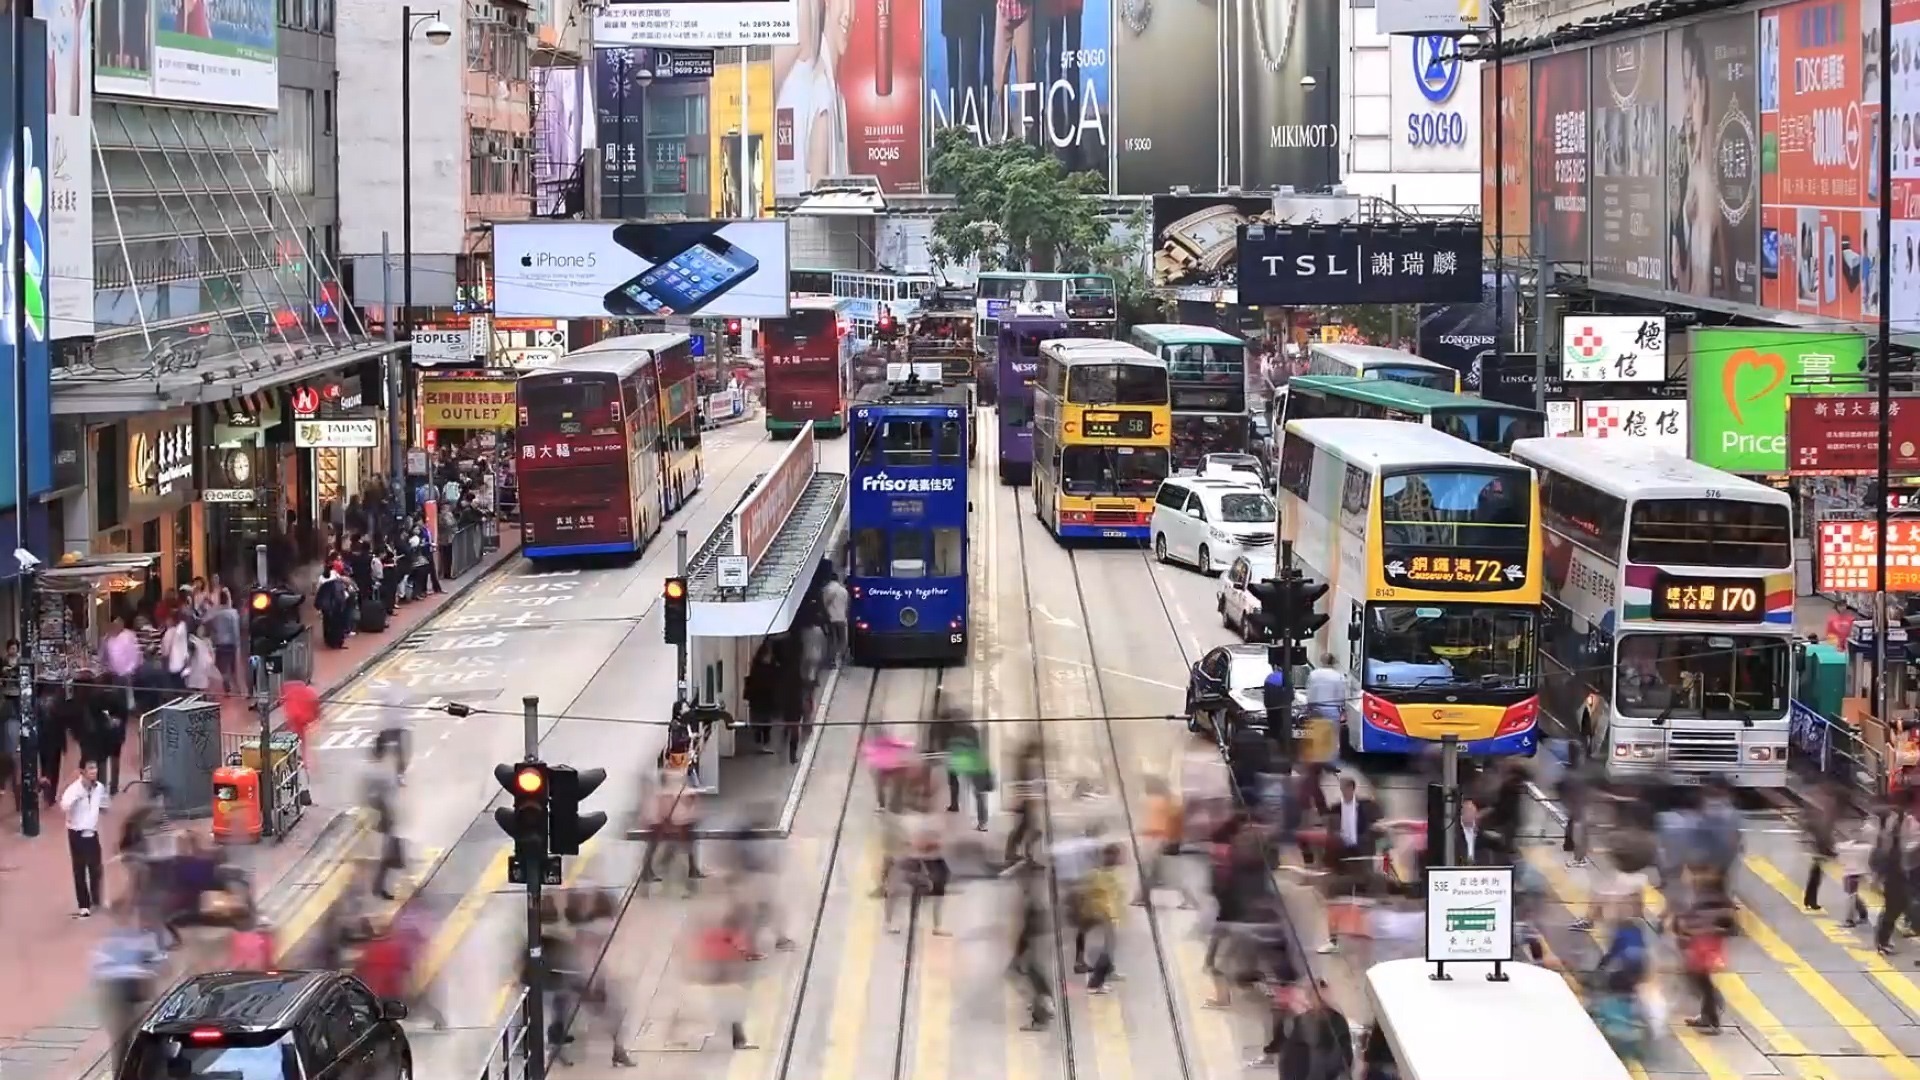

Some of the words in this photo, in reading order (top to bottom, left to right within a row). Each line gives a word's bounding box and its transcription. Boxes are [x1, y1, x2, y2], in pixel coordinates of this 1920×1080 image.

[1077, 49, 1105, 67] SOGO
[1803, 57, 1821, 92] DSC
[930, 78, 1107, 149] NAUTICA
[1408, 112, 1464, 146] SOGO
[1270, 124, 1338, 148] MIKIMOTO
[1134, 138, 1152, 151] SOGO
[868, 146, 901, 162] ROCHAS
[536, 251, 584, 268] iPhone
[587, 251, 597, 268] 5
[1262, 255, 1348, 276] TSL
[1370, 251, 1457, 277] 謝瑞麟
[409, 333, 462, 344] PEOPLES
[1440, 335, 1496, 346] LONGINES
[526, 353, 549, 361] PCCW
[441, 408, 499, 420] OUTLET
[857, 409, 869, 417] 65
[947, 410, 959, 418] 65
[1814, 402, 1902, 417] 新昌大藥房
[328, 424, 373, 433] TAIPAN
[1722, 431, 1787, 454] Price
[862, 471, 907, 491] Friso
[216, 492, 253, 501] OMEGA
[1705, 489, 1721, 498] 576
[1411, 556, 1472, 573] 銅鑼灣
[1475, 560, 1503, 582] 72
[1407, 570, 1455, 582] Causeway
[1456, 571, 1476, 583] Bay
[868, 588, 903, 600] Growing
[905, 590, 913, 599] up
[915, 587, 949, 600] together
[1376, 587, 1395, 597] 8143
[1721, 587, 1757, 612] 170
[950, 634, 963, 644] 65
[1433, 881, 1449, 892] 53E
[1452, 889, 1484, 897] Paterson
[1484, 888, 1507, 897] Street
